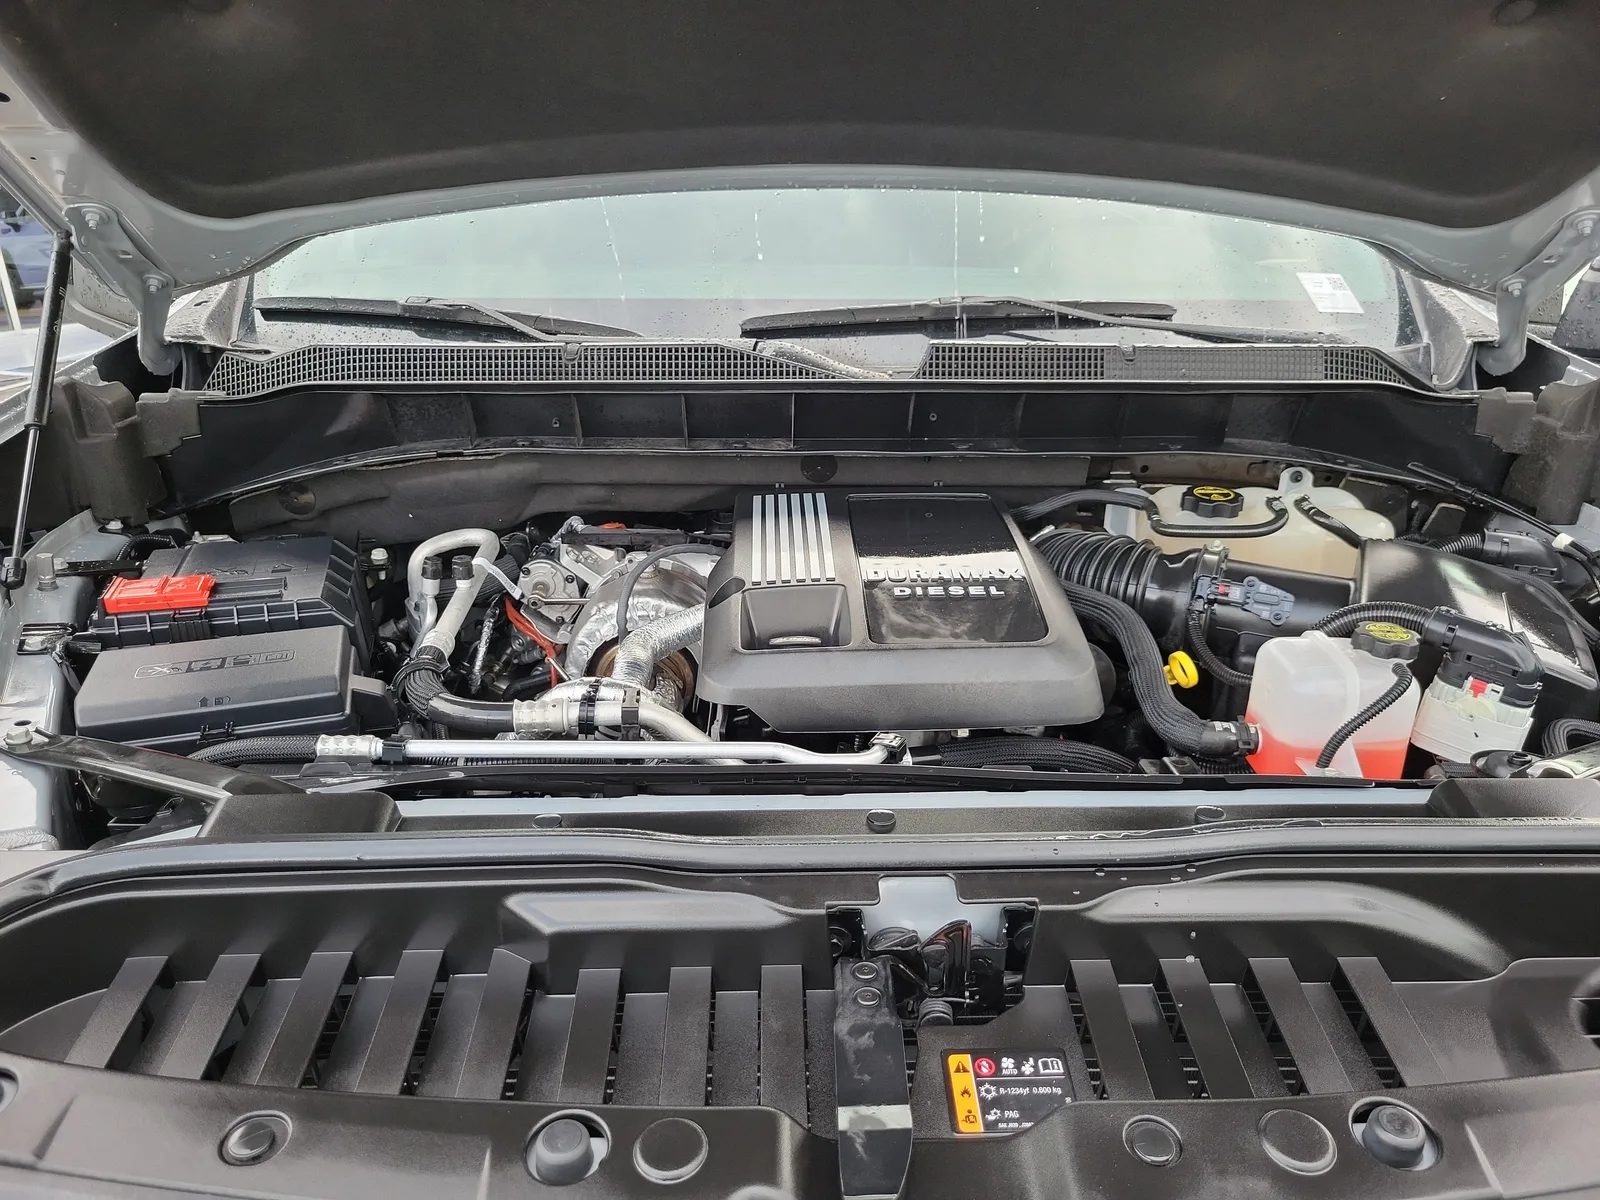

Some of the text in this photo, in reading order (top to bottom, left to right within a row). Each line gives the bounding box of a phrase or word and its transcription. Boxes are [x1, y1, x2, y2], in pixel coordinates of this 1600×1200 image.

[865, 567, 1025, 582] DURAMAX
[893, 585, 1006, 598] DIESEL
[1052, 1087, 1062, 1095] kg
[1004, 1110, 1019, 1118] PAG
